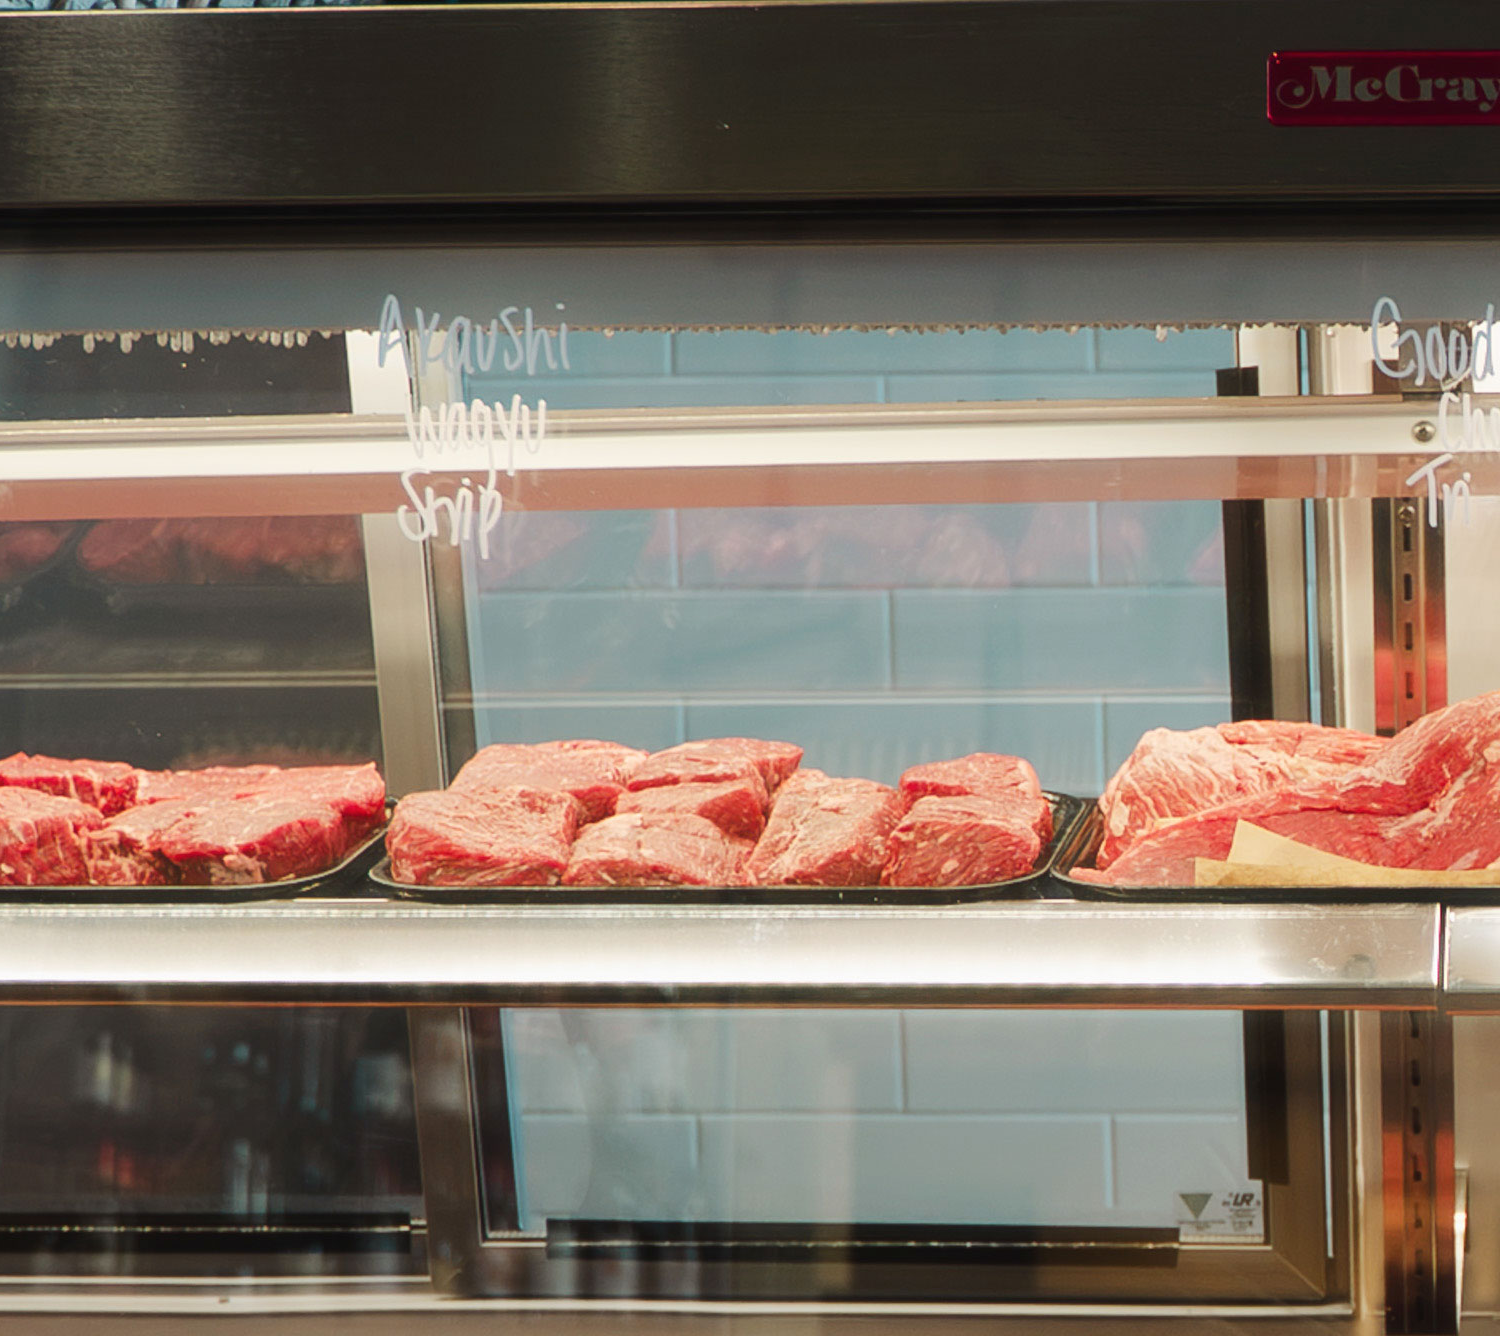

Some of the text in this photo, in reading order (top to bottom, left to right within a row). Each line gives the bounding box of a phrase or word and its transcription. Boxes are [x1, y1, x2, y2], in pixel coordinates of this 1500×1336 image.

[377, 293, 571, 377] Akaushi
[402, 393, 548, 484] Wagyu
[398, 467, 502, 560] Strip
